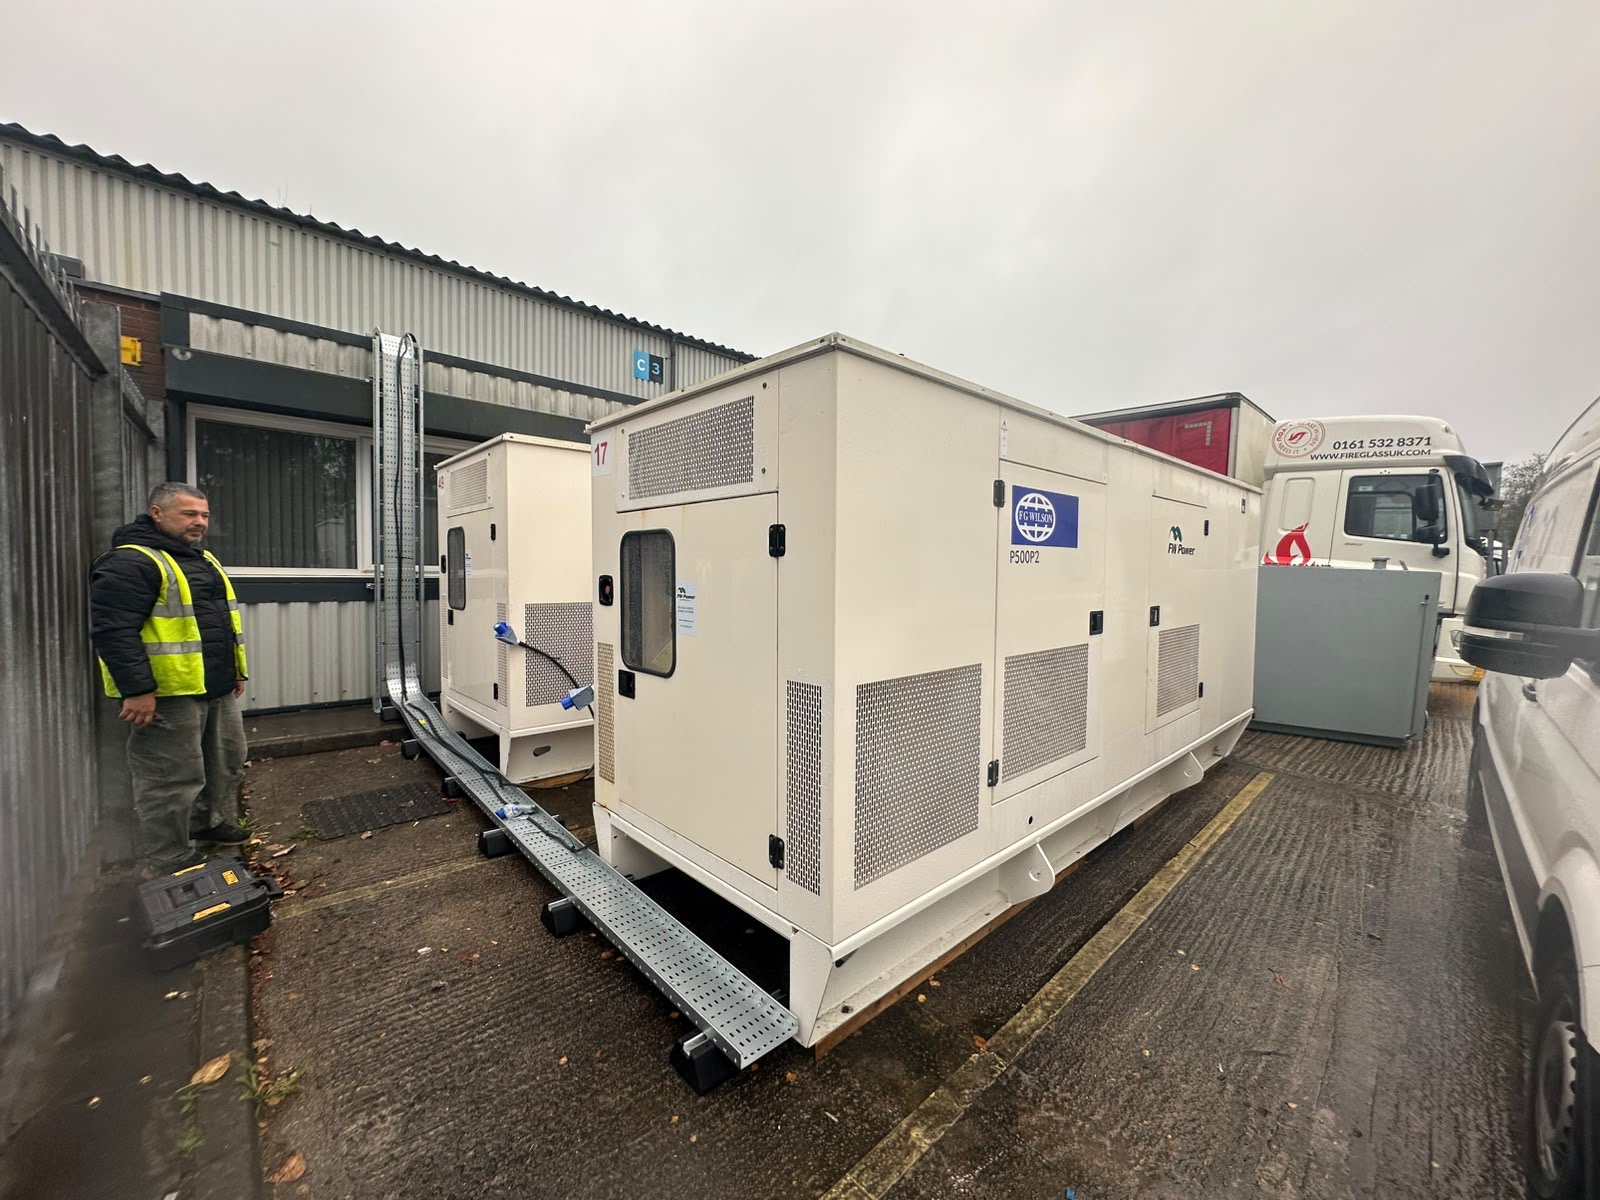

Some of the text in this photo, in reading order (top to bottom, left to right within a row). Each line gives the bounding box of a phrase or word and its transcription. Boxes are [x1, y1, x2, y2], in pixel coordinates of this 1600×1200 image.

[637, 358, 660, 375] C 3
[1276, 426, 1288, 442] YOU
[1332, 436, 1432, 450] 0161 532 8371
[595, 441, 608, 466] 17
[1310, 448, 1432, 461] WWW.FIREGLASSUK.COM
[1029, 511, 1053, 524] WILSON
[1177, 543, 1196, 555] Power
[1009, 550, 1040, 564] P500P2
